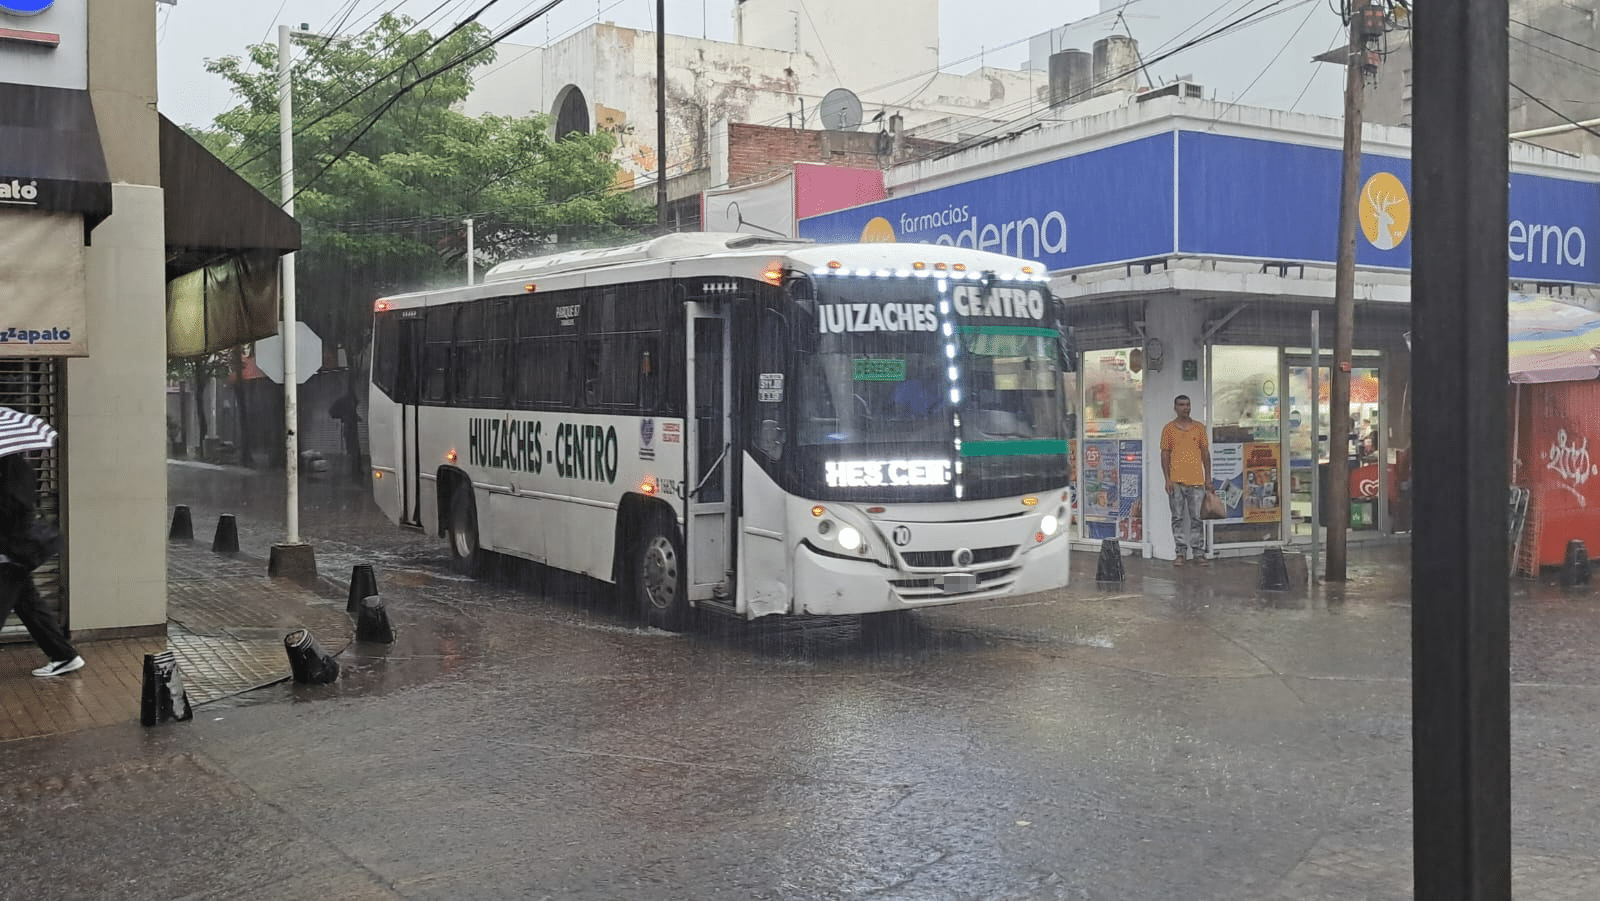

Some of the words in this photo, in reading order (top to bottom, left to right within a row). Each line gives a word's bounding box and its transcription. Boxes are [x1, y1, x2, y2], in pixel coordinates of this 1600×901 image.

[900, 204, 969, 235] farmacias
[920, 210, 1067, 259] derna
[953, 285, 1044, 320] CENTRO
[469, 417, 542, 475] HUIZACHES
[555, 422, 618, 485] CENTRO
